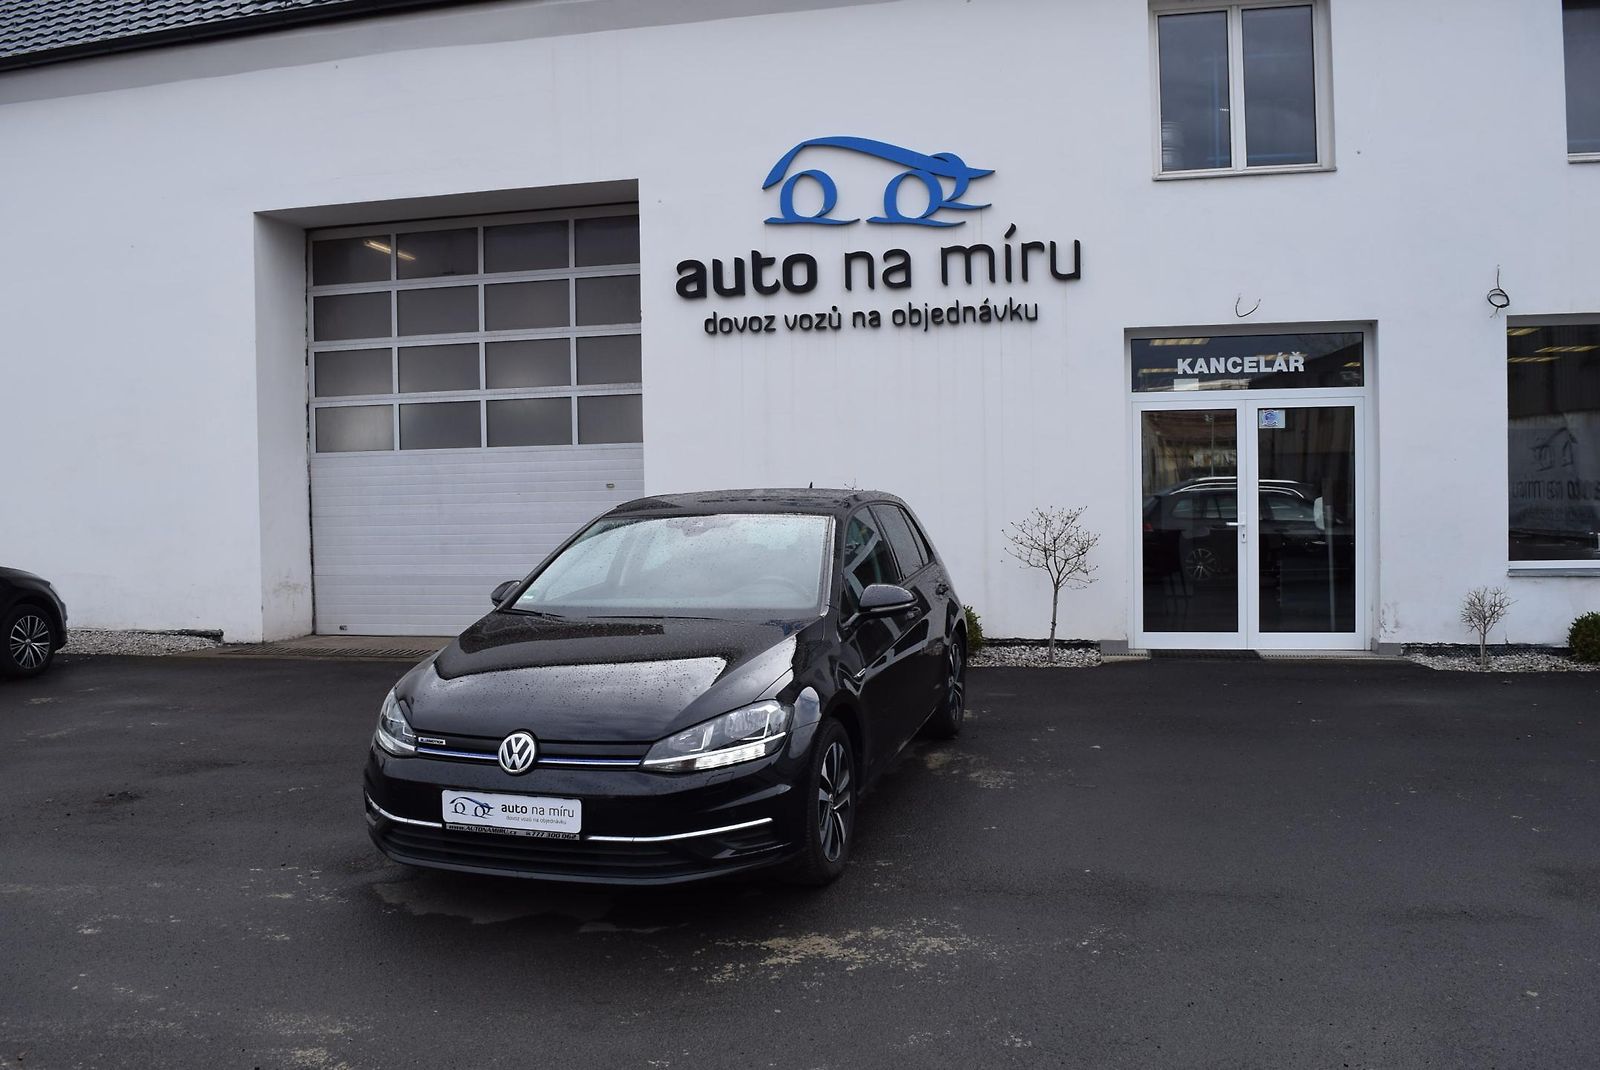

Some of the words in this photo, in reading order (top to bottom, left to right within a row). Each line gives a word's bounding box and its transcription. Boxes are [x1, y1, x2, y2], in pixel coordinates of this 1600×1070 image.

[675, 249, 818, 300] auto
[844, 248, 912, 291] na
[940, 223, 1081, 286] míru
[704, 311, 776, 336] dovoz
[784, 305, 842, 332] vozů
[852, 309, 881, 329] na
[892, 297, 1039, 332] objednávku
[1176, 351, 1305, 375] KANCELÁŘ
[501, 803, 528, 815] auto
[531, 804, 545, 816] na
[549, 804, 575, 818] míru
